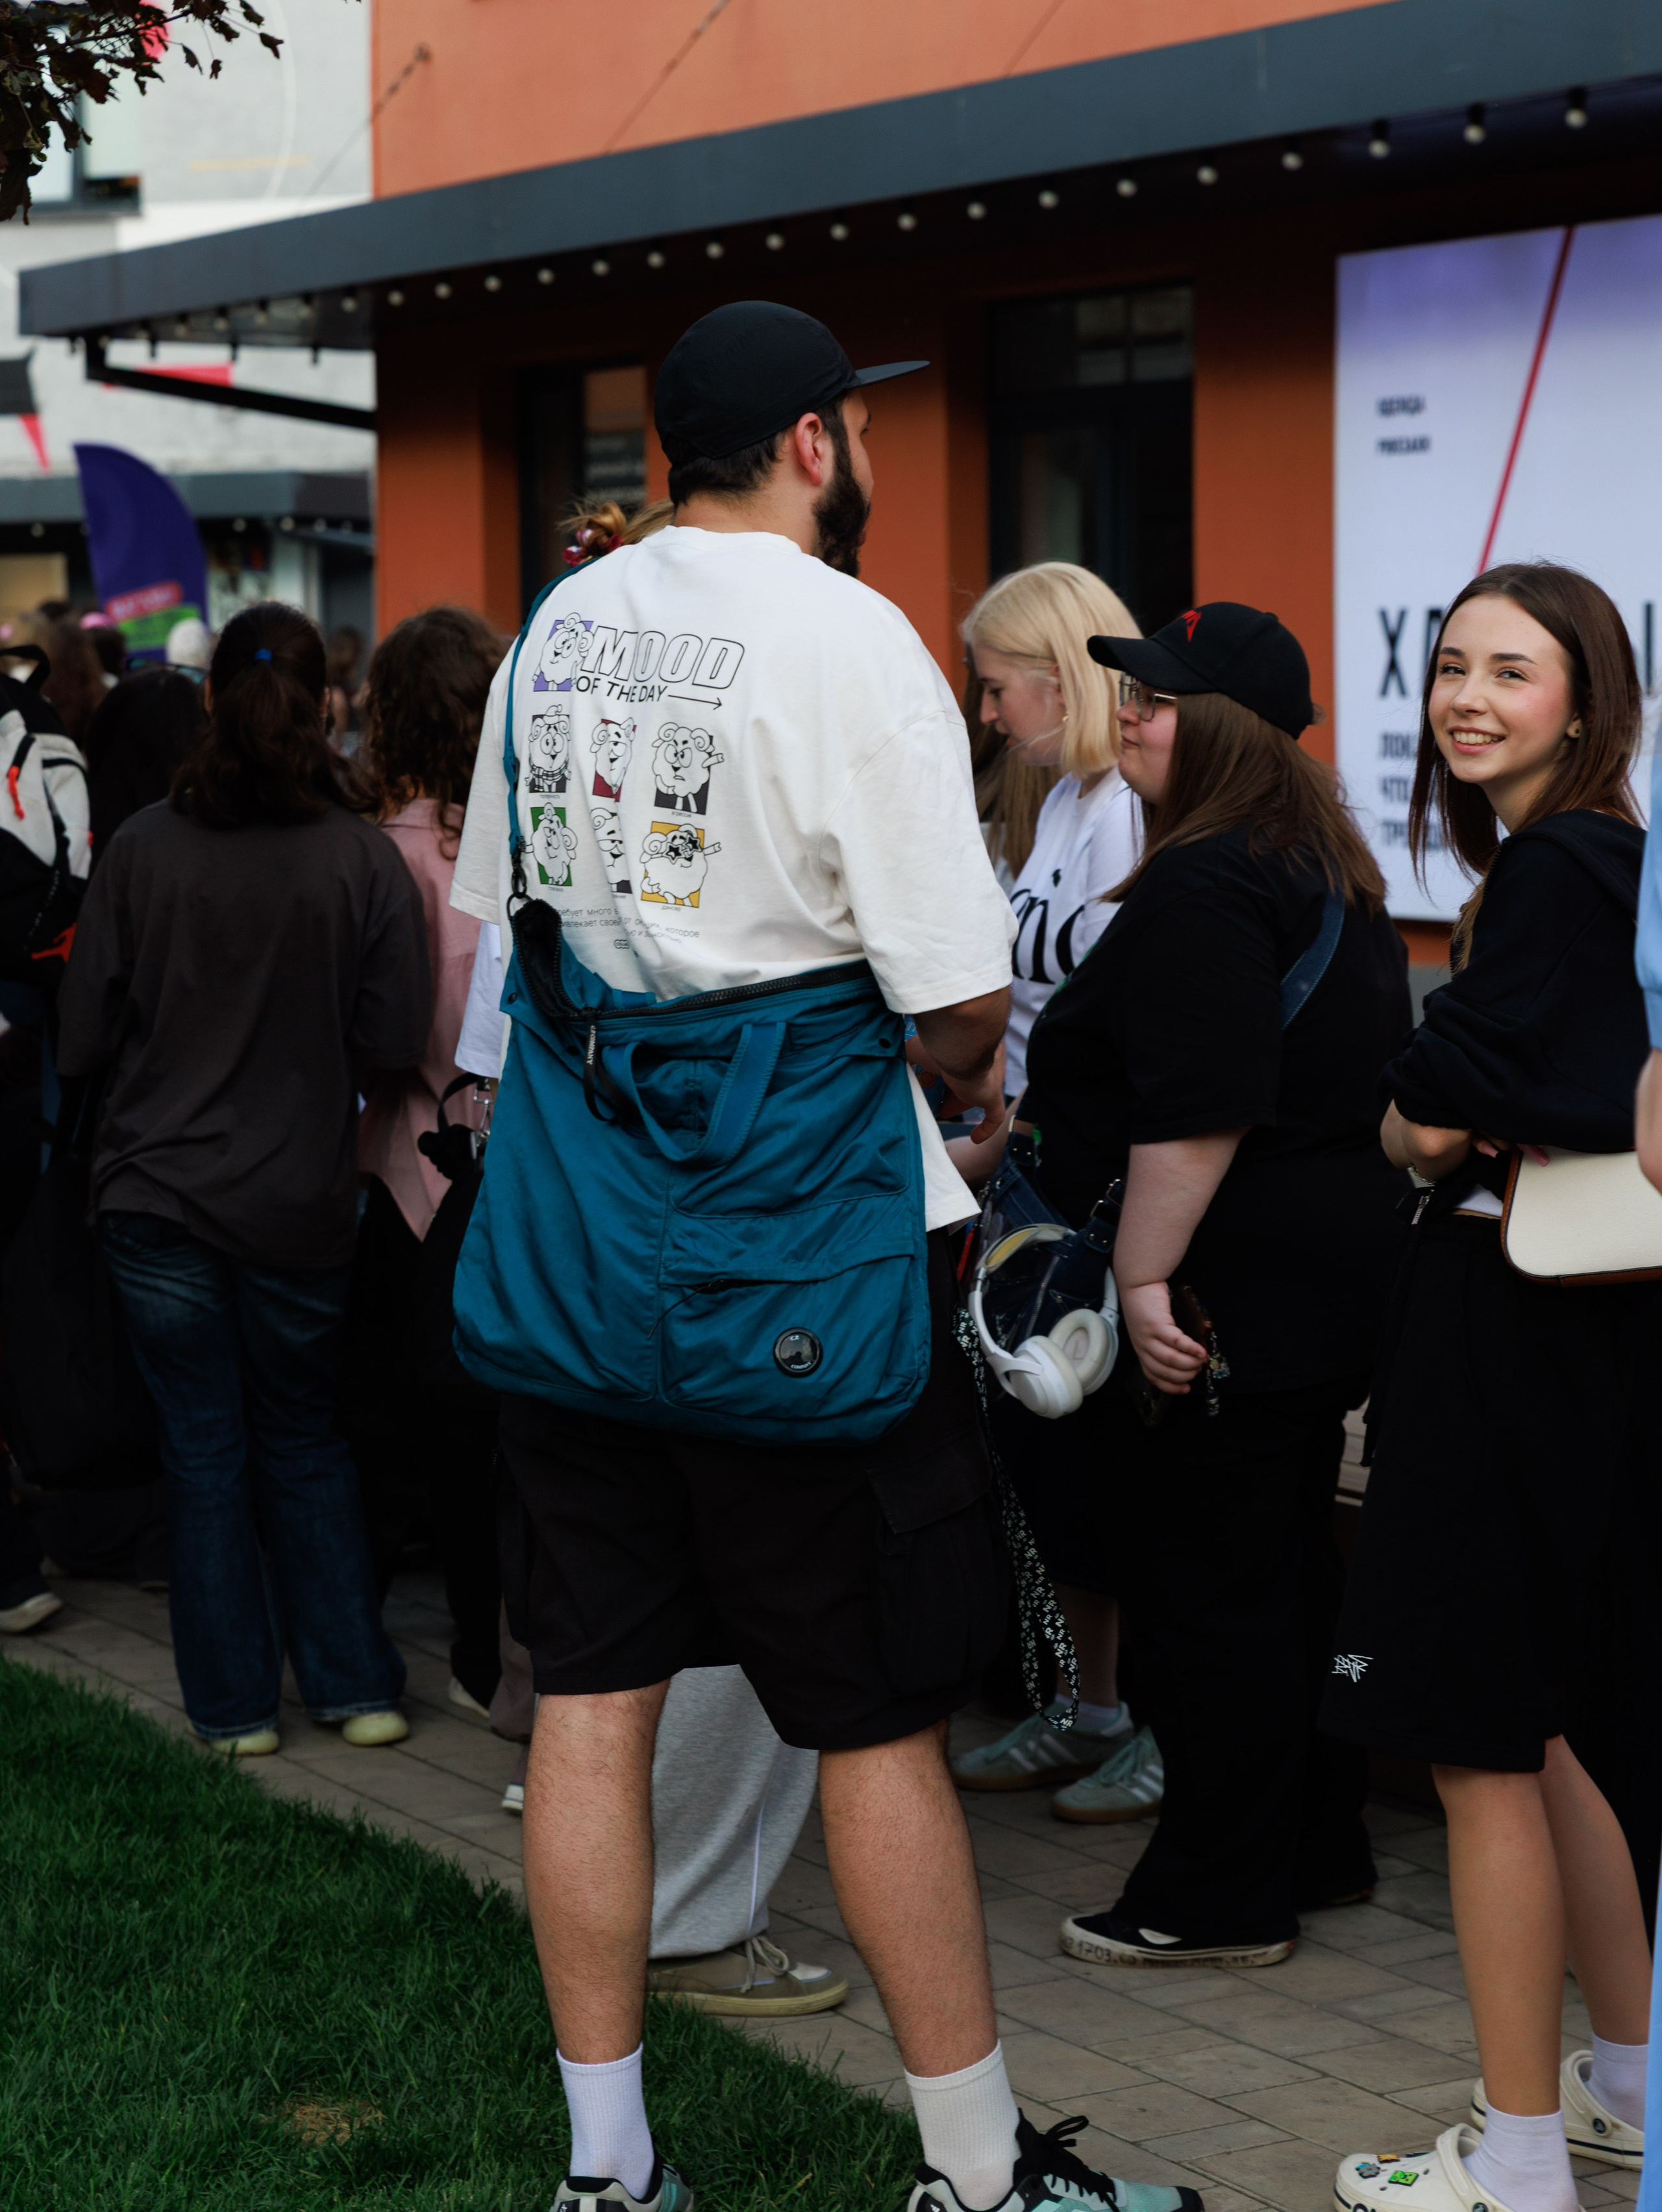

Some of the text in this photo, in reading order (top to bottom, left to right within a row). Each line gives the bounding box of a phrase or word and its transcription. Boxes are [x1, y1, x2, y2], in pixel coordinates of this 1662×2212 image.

[580, 625, 745, 690] MOOD
[576, 675, 668, 702] OF THE DAY
[556, 908, 583, 919] ребует
[587, 908, 612, 916] много
[665, 926, 700, 938] которое
[1024, 1548, 1038, 1559] NR
[1035, 1576, 1045, 1585] NR
[1030, 1587, 1045, 1598] NR
[1043, 1600, 1057, 1613] NR
[1043, 1614, 1052, 1625] NR
[1056, 1629, 1065, 1640] NR
[1055, 1642, 1067, 1658] NR
[1068, 1657, 1078, 1672] NR
[1070, 1674, 1076, 1685] NR
[1060, 1718, 1073, 1727] NR
